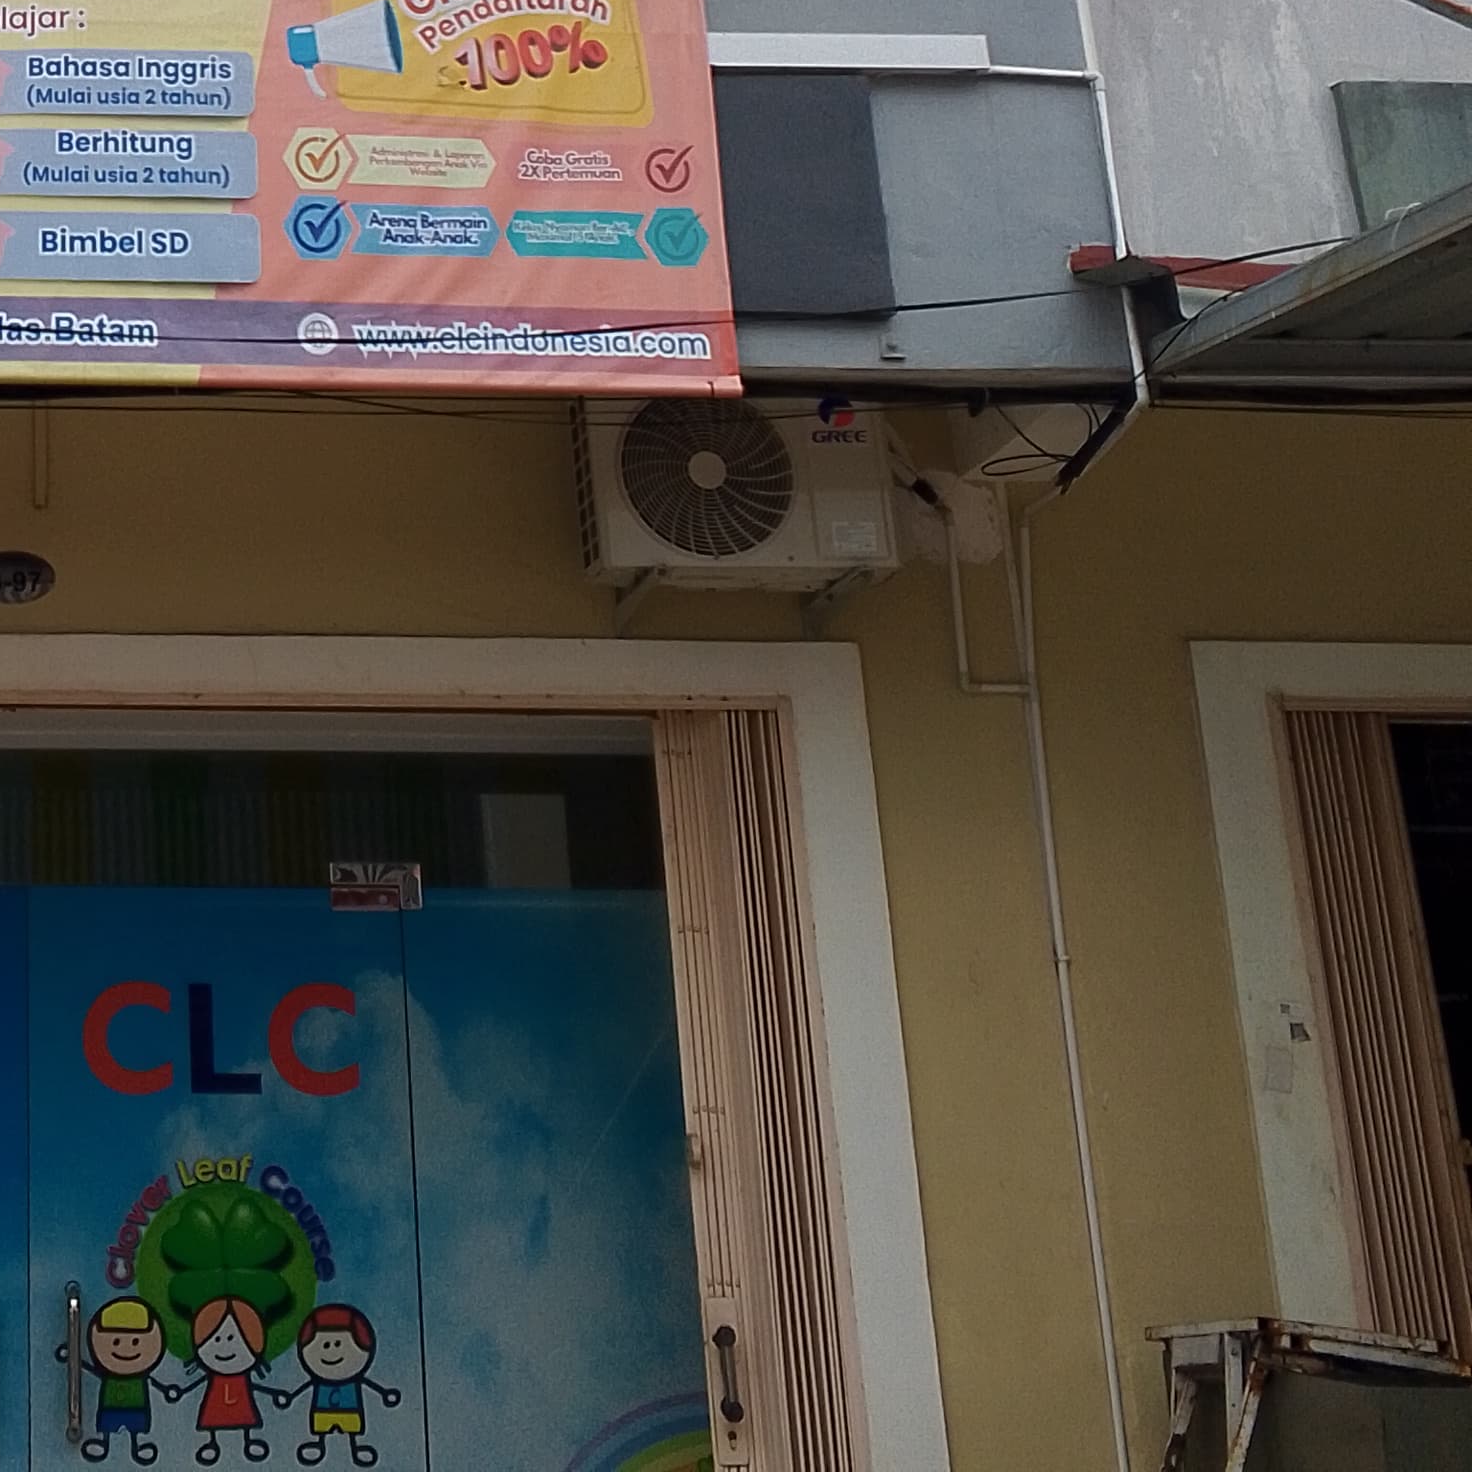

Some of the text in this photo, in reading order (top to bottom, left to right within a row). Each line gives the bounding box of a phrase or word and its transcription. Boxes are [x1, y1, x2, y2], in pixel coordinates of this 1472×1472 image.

[454, 22, 609, 91] 100%
[28, 56, 233, 85] Bahasa Inggris
[26, 87, 232, 111] (Mulai usia 2 tahun)
[57, 132, 194, 160] Berhitung
[527, 150, 610, 166] Coba Gratis
[22, 164, 230, 188] (Mulai usia 2 tahun)
[520, 165, 622, 181] 2X Pertemuan
[370, 210, 489, 230] Arena Bermain
[40, 229, 190, 255] Bimbel SD
[382, 229, 479, 245] Anak-Anak.
[811, 430, 868, 444] GREE
[82, 980, 361, 1097] CLC
[106, 1152, 336, 1288] Clover Leaf Course
